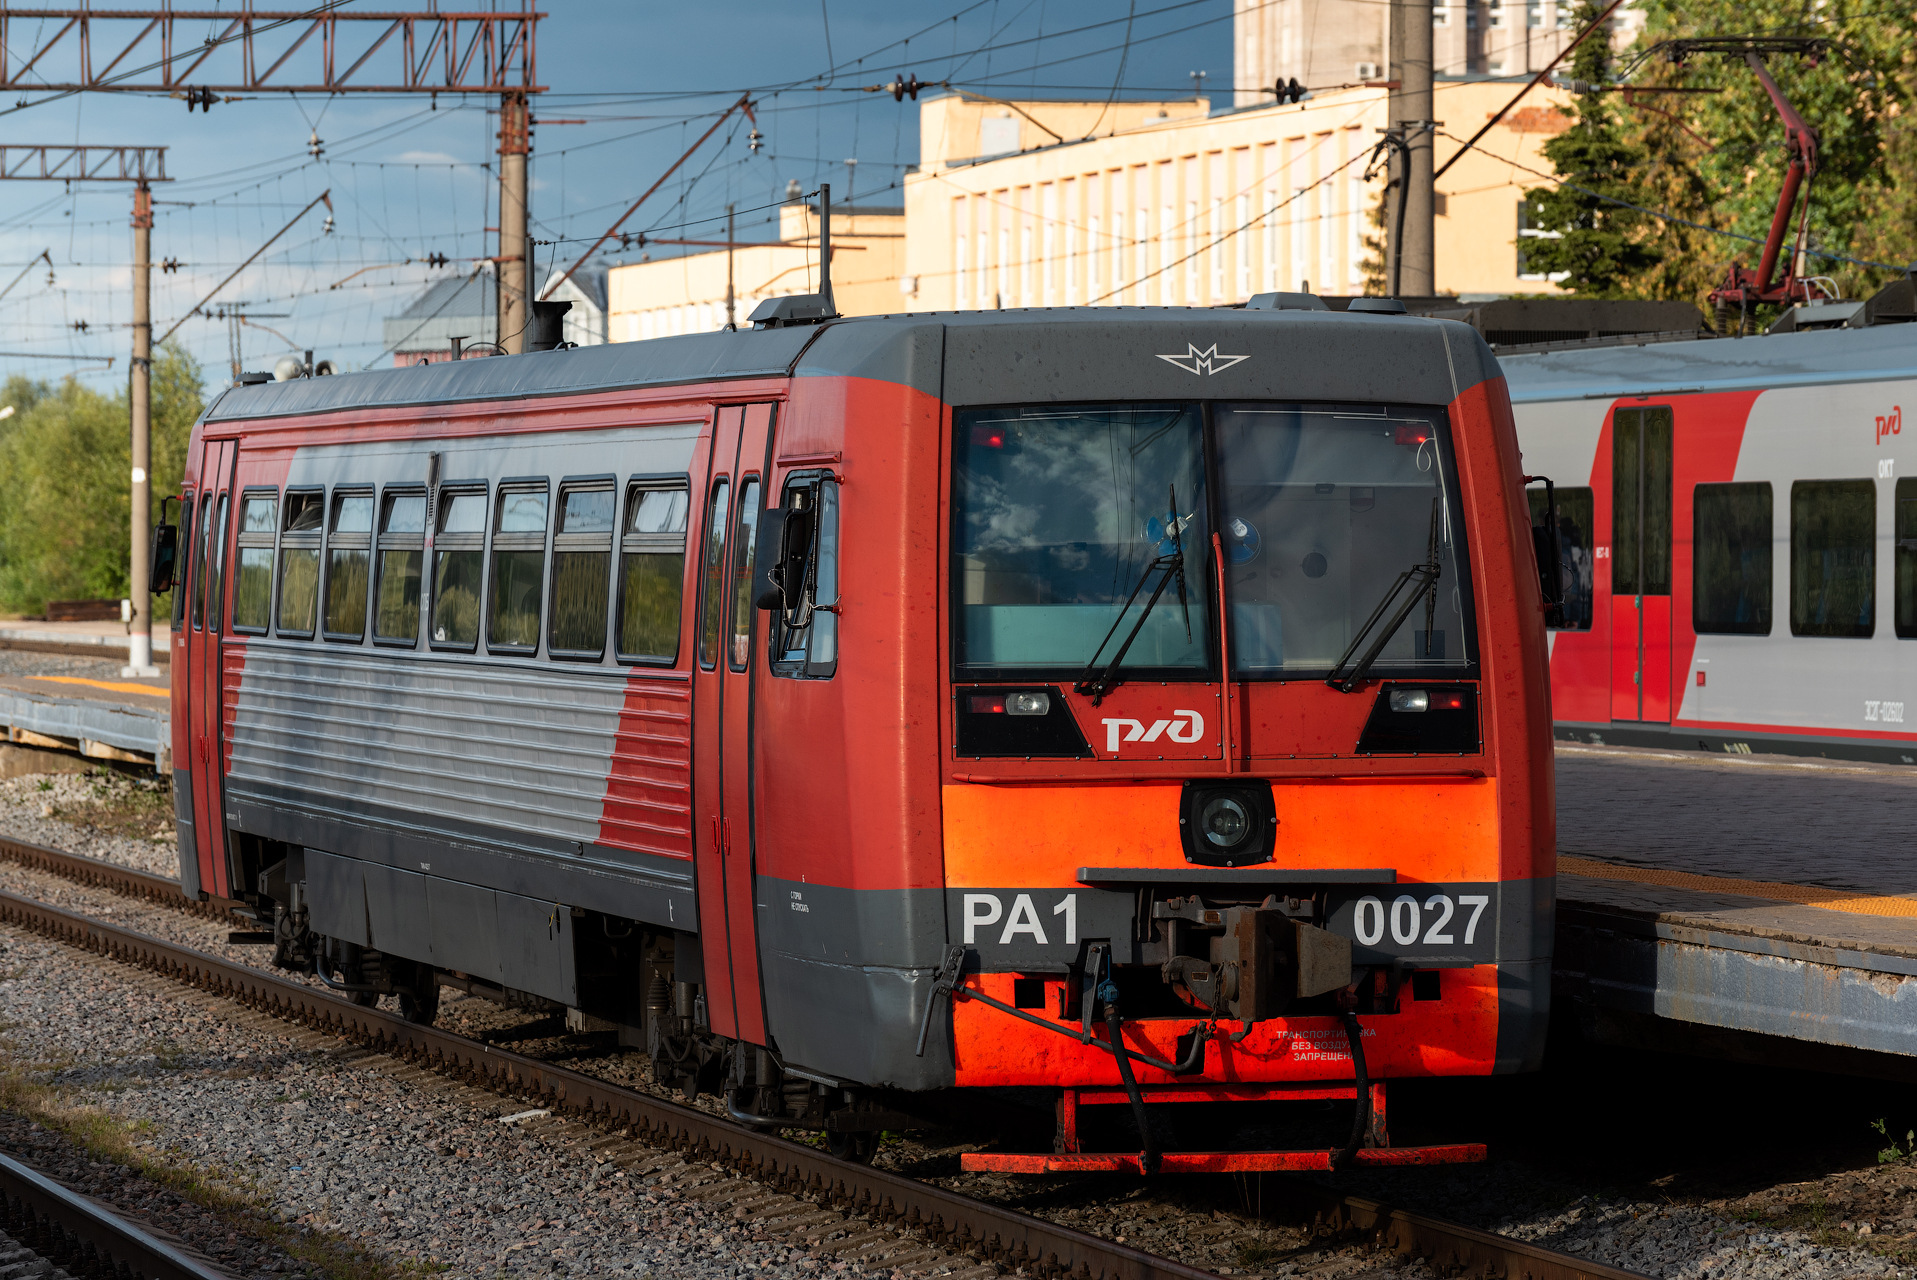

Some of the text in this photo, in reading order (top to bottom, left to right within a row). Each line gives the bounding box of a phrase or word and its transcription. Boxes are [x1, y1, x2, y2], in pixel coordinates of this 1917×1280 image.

[963, 893, 1076, 945] РА1
[1354, 894, 1489, 946] 0027
[1291, 1041, 1311, 1050] БЕЗ
